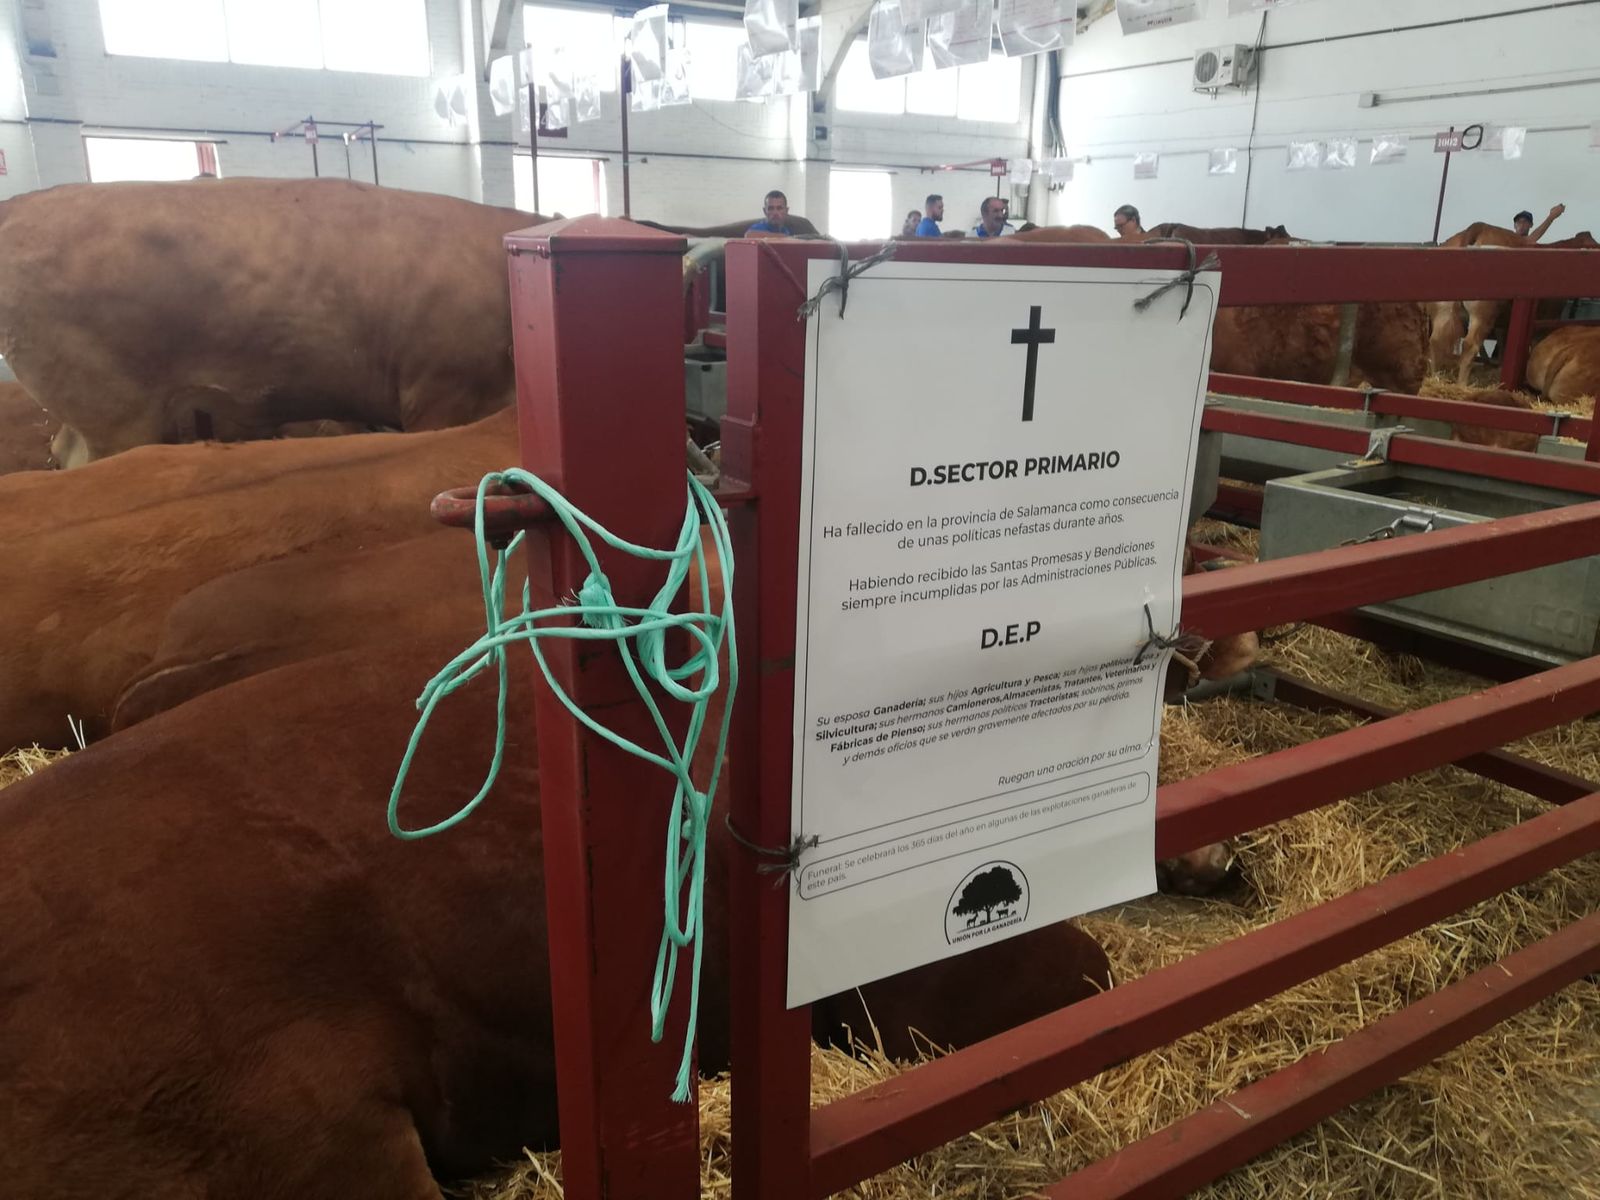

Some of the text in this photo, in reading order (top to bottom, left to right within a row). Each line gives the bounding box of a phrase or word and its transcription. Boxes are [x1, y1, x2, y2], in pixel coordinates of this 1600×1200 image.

[909, 449, 1121, 487] D.SECTOR PRIMARIO
[823, 489, 1179, 539] Ha fallecido en la provincia de Salamanca como consecuencia
[897, 512, 1125, 549] de unas políticas nefastas durante años.
[841, 555, 1157, 611] siempre incumplidas por las Administraciones Públicas.
[849, 539, 1155, 591] Habiendo recibido las Santas Promesas y Bendiciones
[980, 620, 1042, 649] D.E.P
[815, 720, 878, 741] Silvicultura;
[878, 718, 895, 729] sus
[896, 707, 945, 725] hermanos
[1105, 663, 1151, 679] Veterinarios
[1150, 662, 1158, 671] y
[816, 716, 831, 727] Su
[833, 709, 870, 724] esposa
[873, 697, 927, 716] Ganadería;
[928, 695, 945, 705] sus
[946, 687, 968, 702] hijos
[970, 678, 1022, 696] Agricultura
[1024, 677, 1031, 687] y
[1033, 671, 1060, 684] Pesca;
[830, 735, 874, 753] Fábricas
[875, 732, 889, 743] de
[890, 725, 926, 740] Pienso;
[927, 721, 943, 731] sus
[944, 711, 990, 726] hermanos
[991, 702, 1028, 719] políticos
[1029, 691, 1080, 708] Tractoristas;
[1116, 676, 1143, 689] primos
[842, 755, 850, 766] y
[851, 746, 885, 763] demás
[887, 739, 917, 754] oficios
[919, 735, 937, 748] que
[938, 733, 949, 742] se
[950, 727, 976, 739] verán
[977, 714, 1030, 734] gravemente
[1031, 702, 1072, 719] afectados
[1073, 699, 1087, 712] por
[1088, 697, 1098, 707] su
[998, 742, 1143, 786] Ruegan una oración por su alma.
[844, 859, 855, 868] Se
[857, 847, 896, 865] celebrará
[897, 843, 910, 854] los
[911, 840, 926, 850] 365
[926, 833, 944, 845] días
[945, 829, 958, 840] del
[959, 826, 975, 837] año
[976, 822, 986, 832] en
[988, 813, 1018, 830] algunas
[1019, 809, 1029, 820] de
[1030, 806, 1041, 817] las
[1042, 794, 1090, 814] explotaciones
[1127, 781, 1136, 791] de
[807, 880, 826, 891] este
[971, 929, 983, 938] POR
